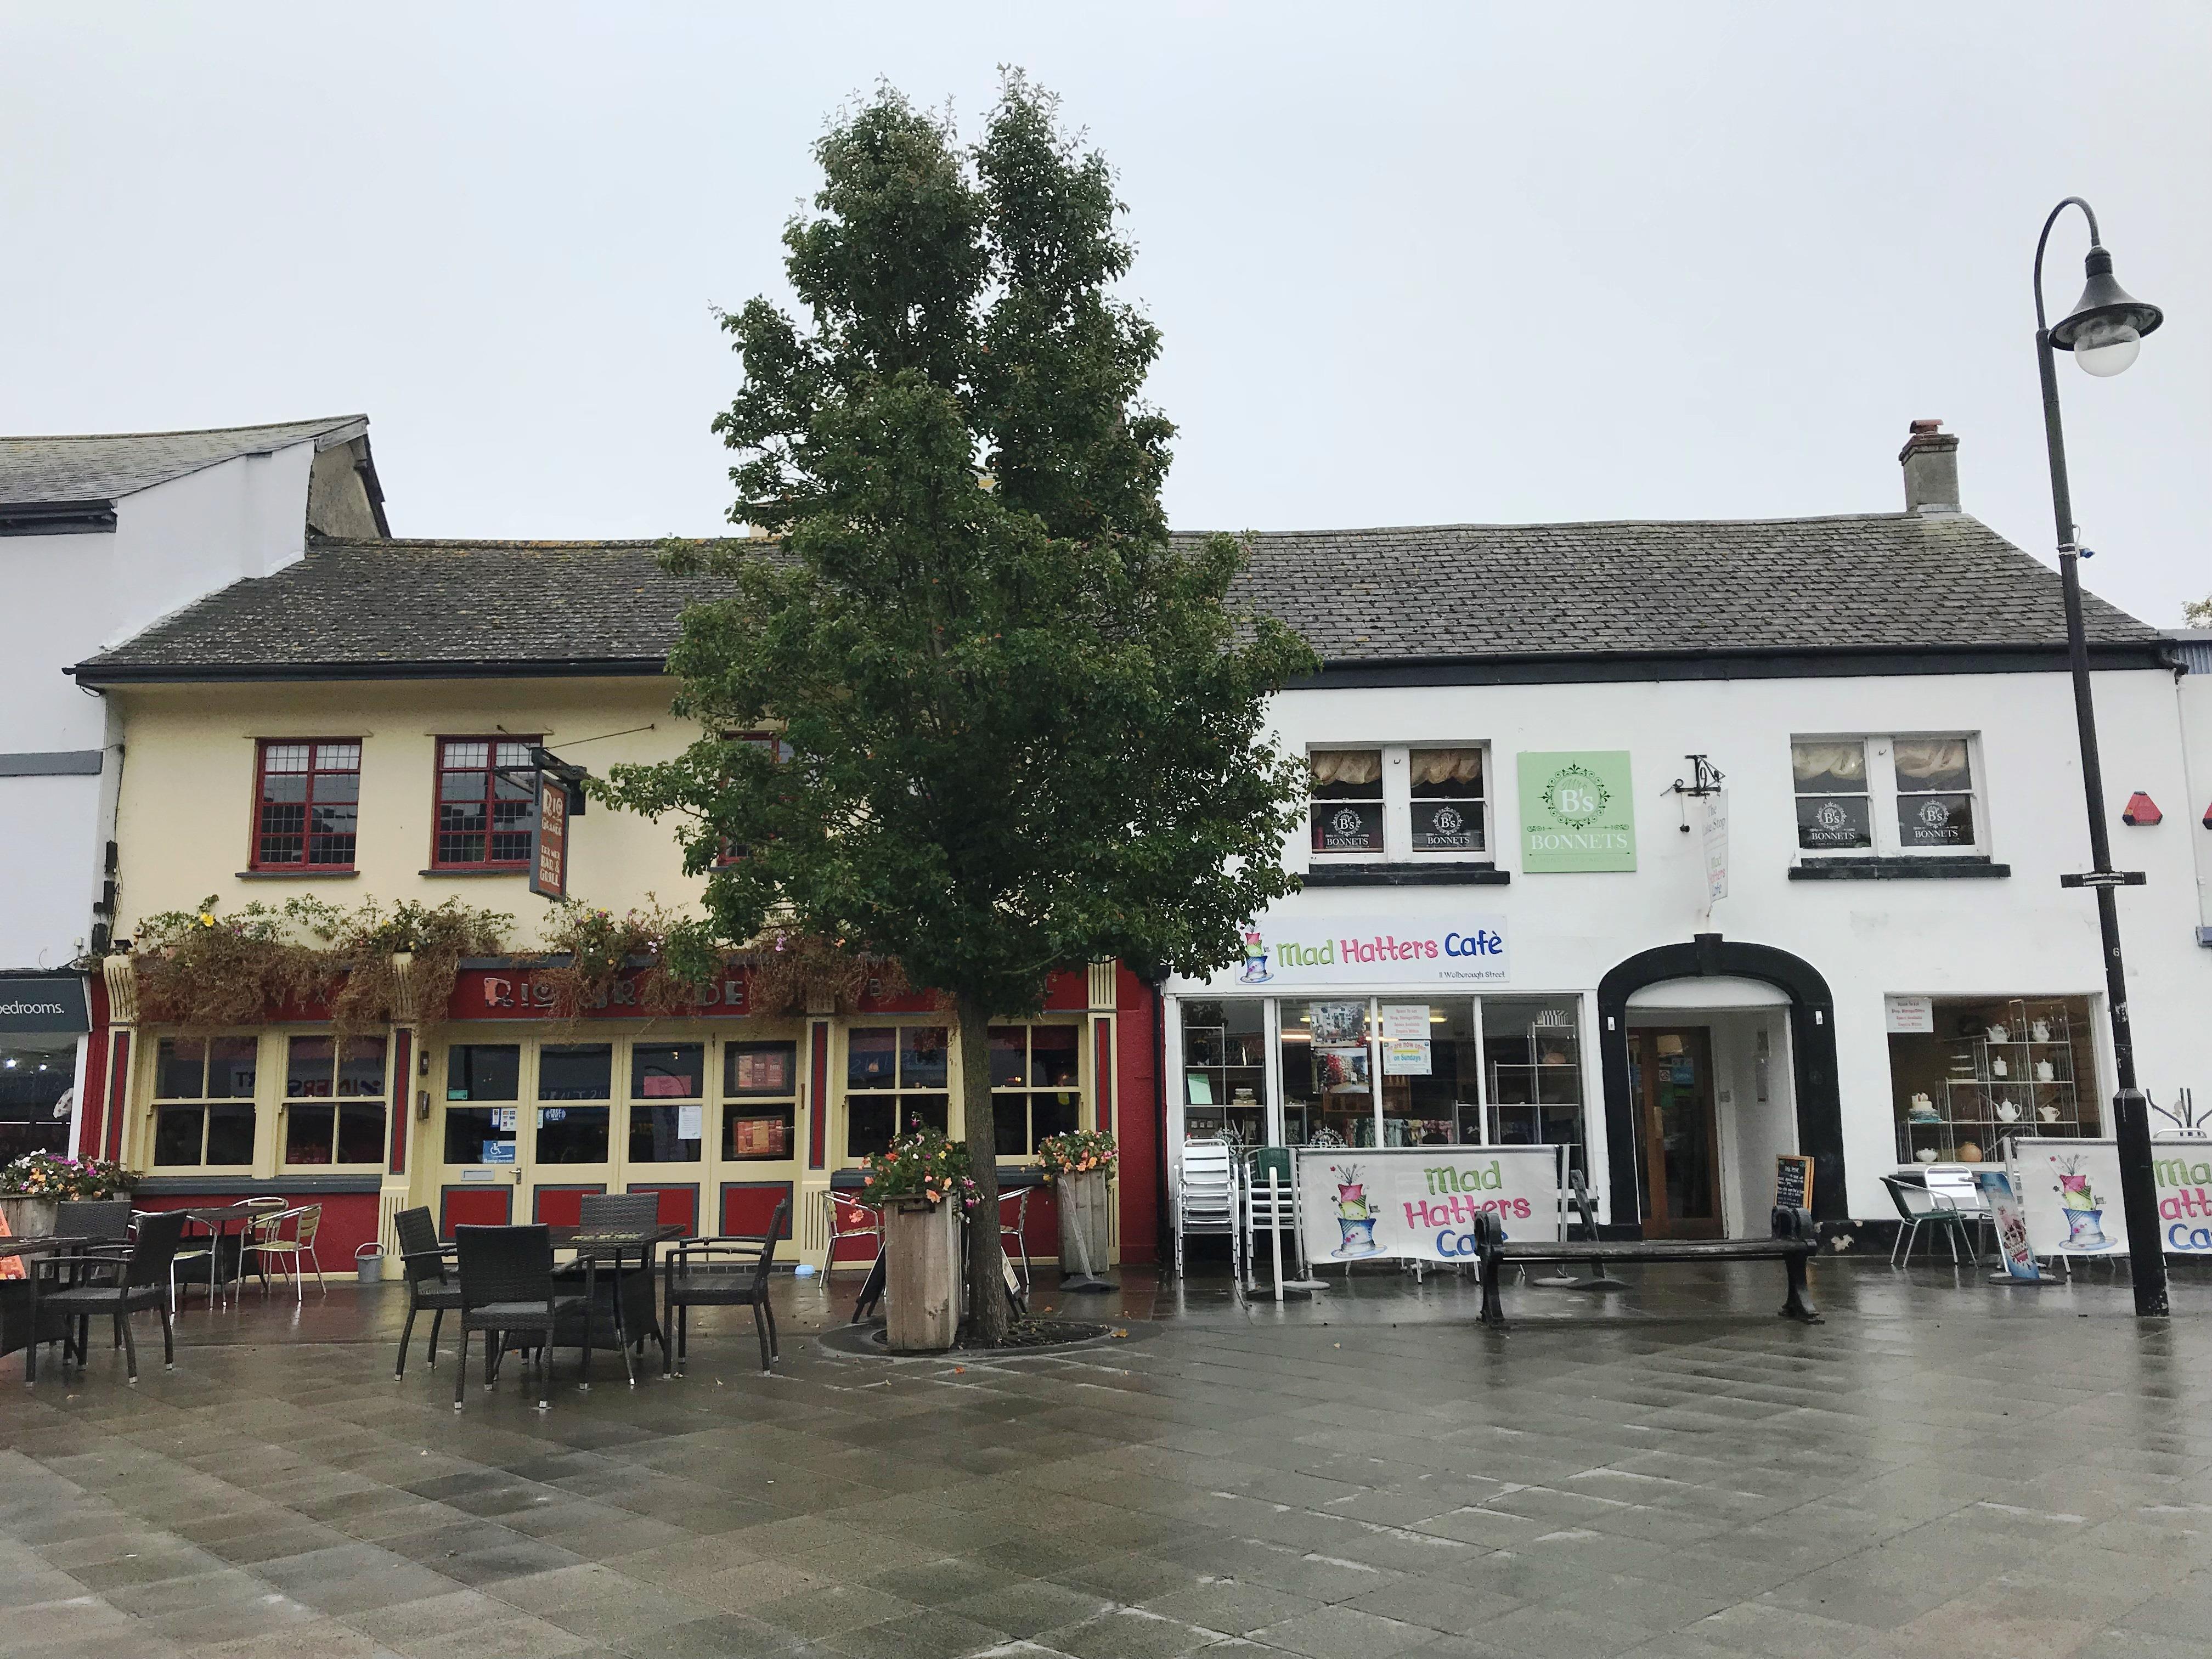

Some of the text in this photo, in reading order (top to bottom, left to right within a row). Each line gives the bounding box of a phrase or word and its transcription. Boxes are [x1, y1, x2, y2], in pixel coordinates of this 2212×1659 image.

[543, 788, 563, 817] RIO
[1559, 788, 1594, 812] B's
[1707, 804, 1717, 817] The
[1824, 812, 1839, 823] B's
[1926, 810, 1943, 822] B's
[541, 817, 562, 836] GRANDE
[1339, 817, 1355, 830] B's
[1440, 815, 1456, 828] B's
[1327, 837, 1369, 846] BONNETS
[1427, 837, 1470, 845] BONNETS
[1531, 833, 1628, 850] BONNETS
[1812, 832, 1855, 840] BONNETS
[1915, 830, 1958, 838] BONNETS
[541, 855, 553, 871] BAR
[540, 868, 560, 887] GRILL
[1276, 939, 1335, 967] Mad
[1340, 936, 1438, 963] Hatters
[2113, 947, 2120, 957] 6
[483, 978, 554, 1008] RIO
[1401, 1054, 1421, 1062] Sundays
[1424, 1160, 1502, 1195] Mad
[2153, 1158, 2212, 1187] Ma
[1403, 1195, 1531, 1229] Hatters
[1436, 1229, 1509, 1257] Ca
[2169, 1223, 2212, 1250] Ca
